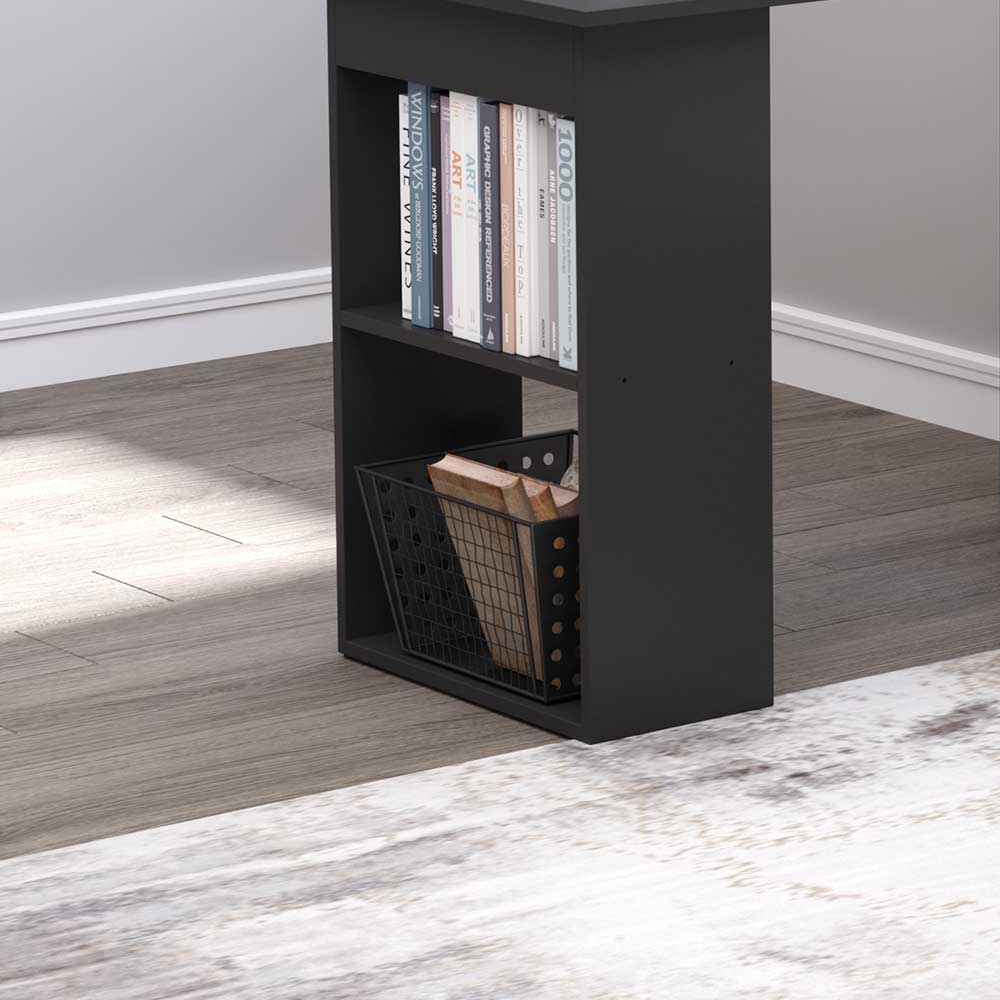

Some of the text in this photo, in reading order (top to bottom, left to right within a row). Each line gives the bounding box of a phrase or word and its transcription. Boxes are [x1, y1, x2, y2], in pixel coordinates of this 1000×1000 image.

[410, 91, 424, 190] WINDOWS
[558, 128, 573, 202] 1000
[452, 151, 463, 190] ART
[466, 153, 476, 193] ART
[484, 181, 492, 224] DESIGN
[485, 227, 493, 303] REFERENCED
